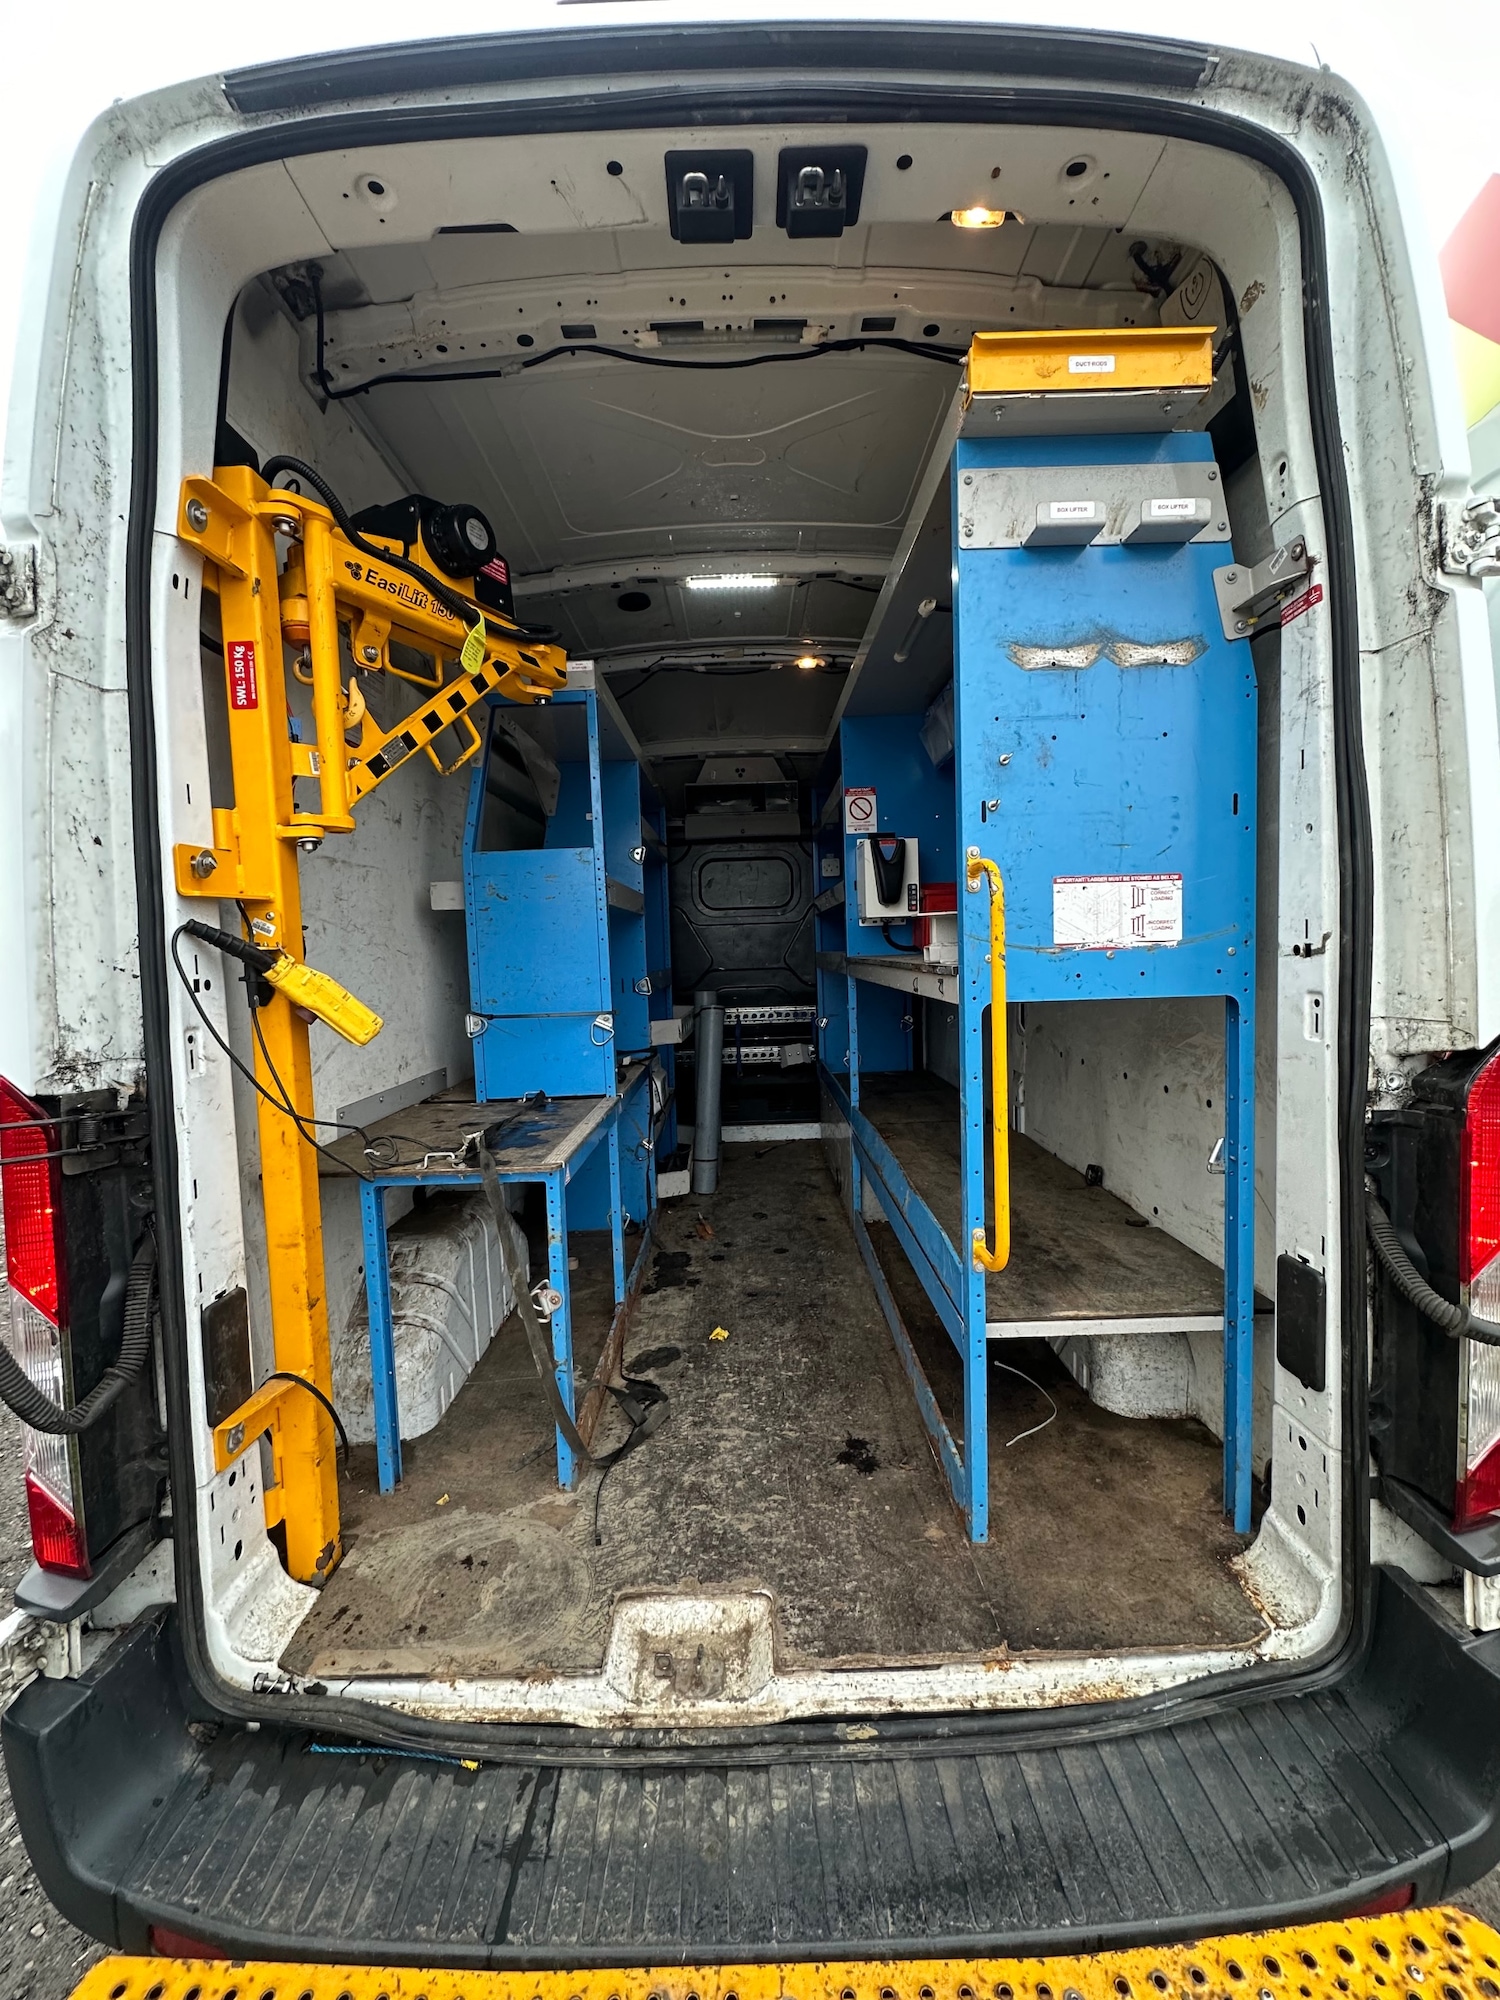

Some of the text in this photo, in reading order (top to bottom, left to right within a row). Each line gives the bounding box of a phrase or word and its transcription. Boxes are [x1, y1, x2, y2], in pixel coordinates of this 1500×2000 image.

[364, 568, 429, 609] EasiLift
[430, 599, 456, 621] 150
[232, 646, 247, 706] SWL: 150 Kg
